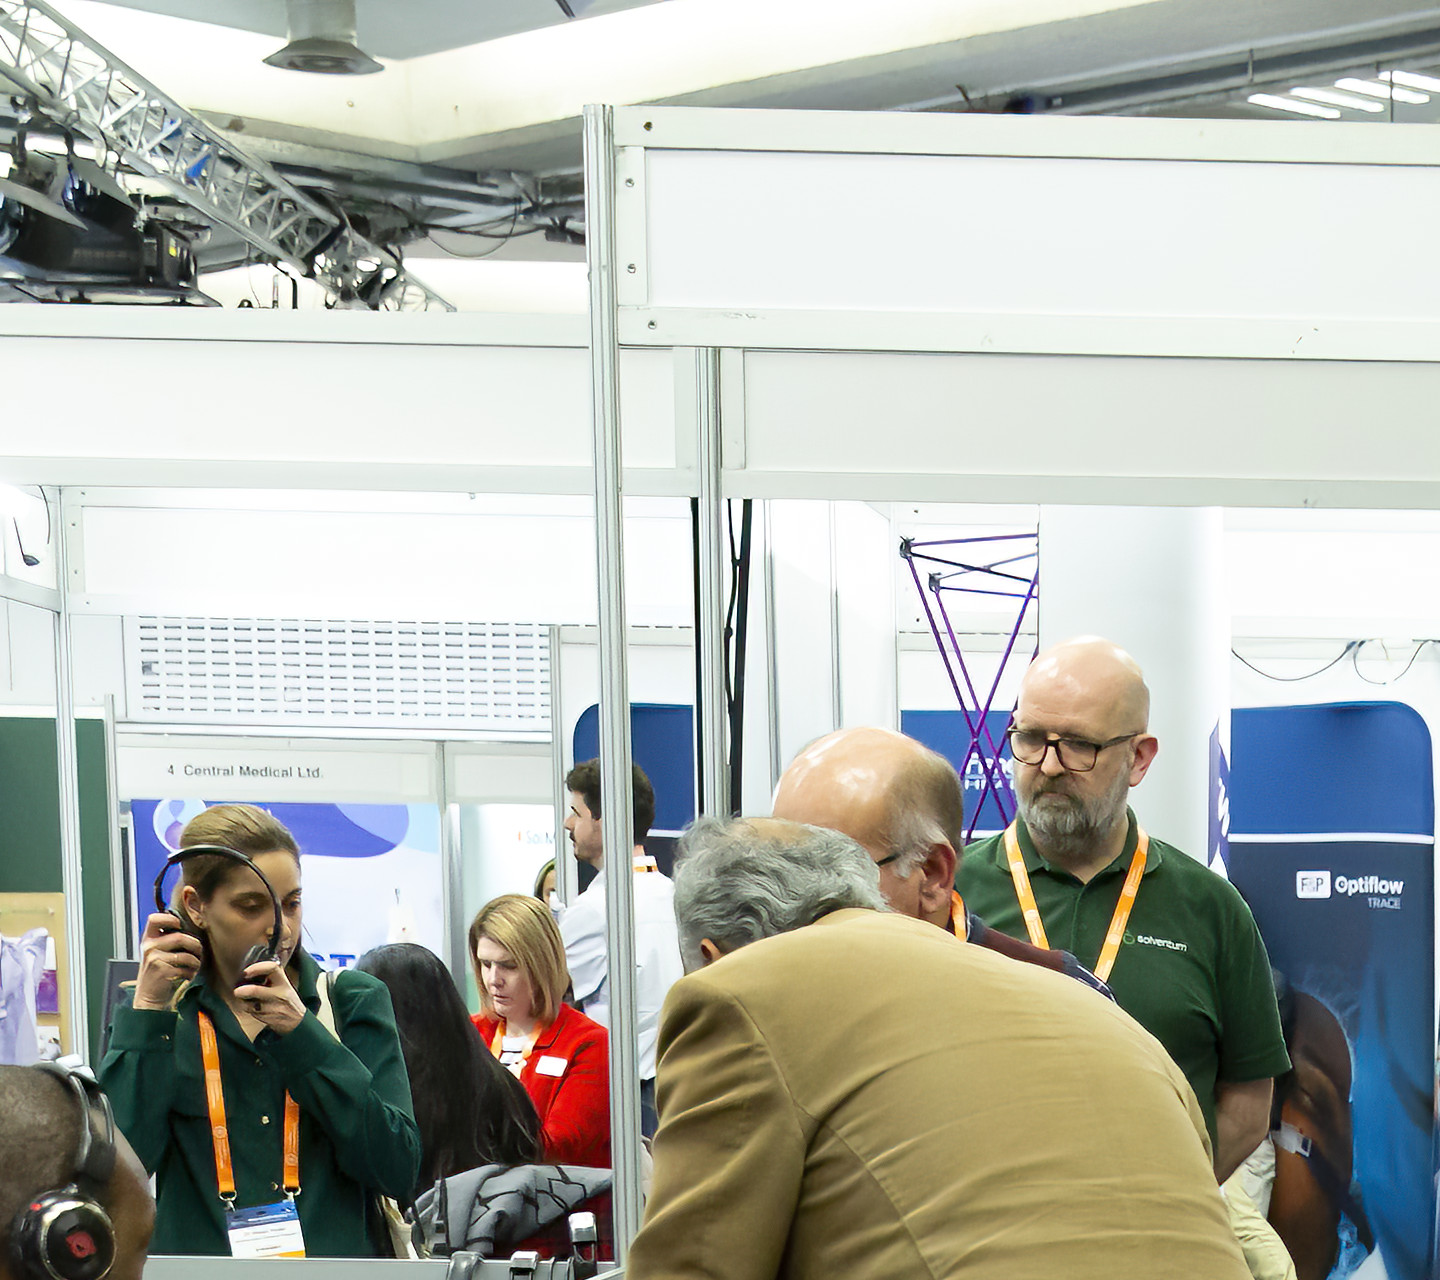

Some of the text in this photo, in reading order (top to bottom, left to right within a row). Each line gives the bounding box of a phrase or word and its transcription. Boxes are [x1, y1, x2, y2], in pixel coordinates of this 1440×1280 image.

[167, 764, 324, 778] 4 Central Medical Ltd.
[1334, 875, 1404, 897] Optiflow
[1367, 897, 1401, 910] TRACE
[1137, 934, 1188, 952] solventum
